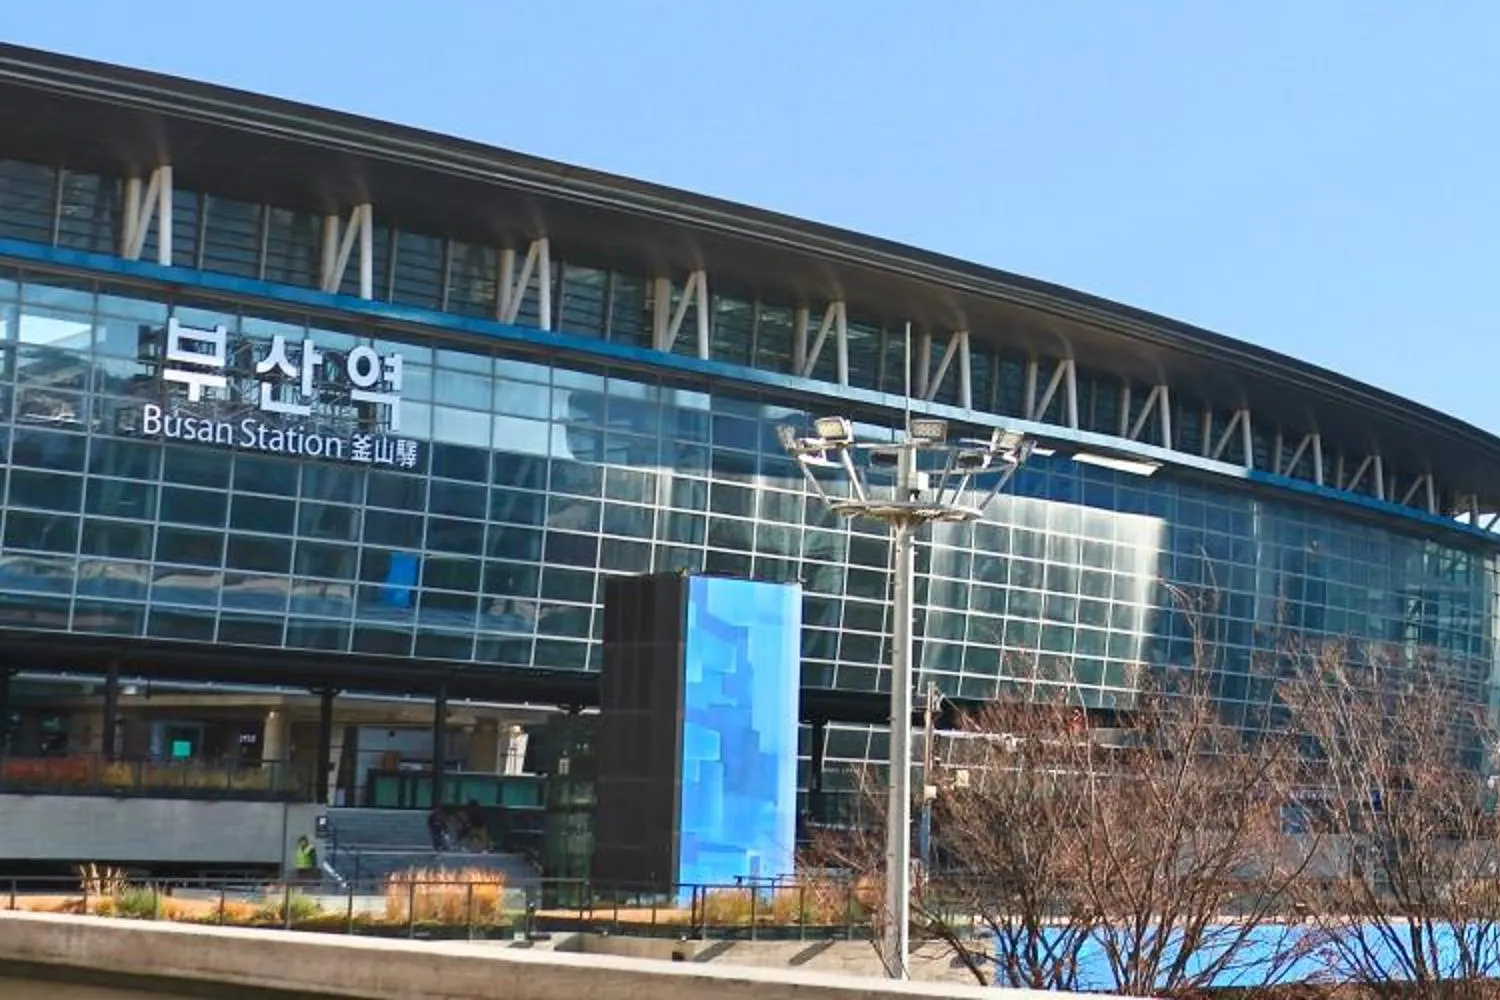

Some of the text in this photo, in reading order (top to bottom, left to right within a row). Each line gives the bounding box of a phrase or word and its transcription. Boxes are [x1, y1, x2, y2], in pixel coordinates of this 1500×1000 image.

[163, 316, 403, 433] 부산역
[143, 404, 342, 458] Busan Station
[351, 432, 418, 469] 釜山驛
